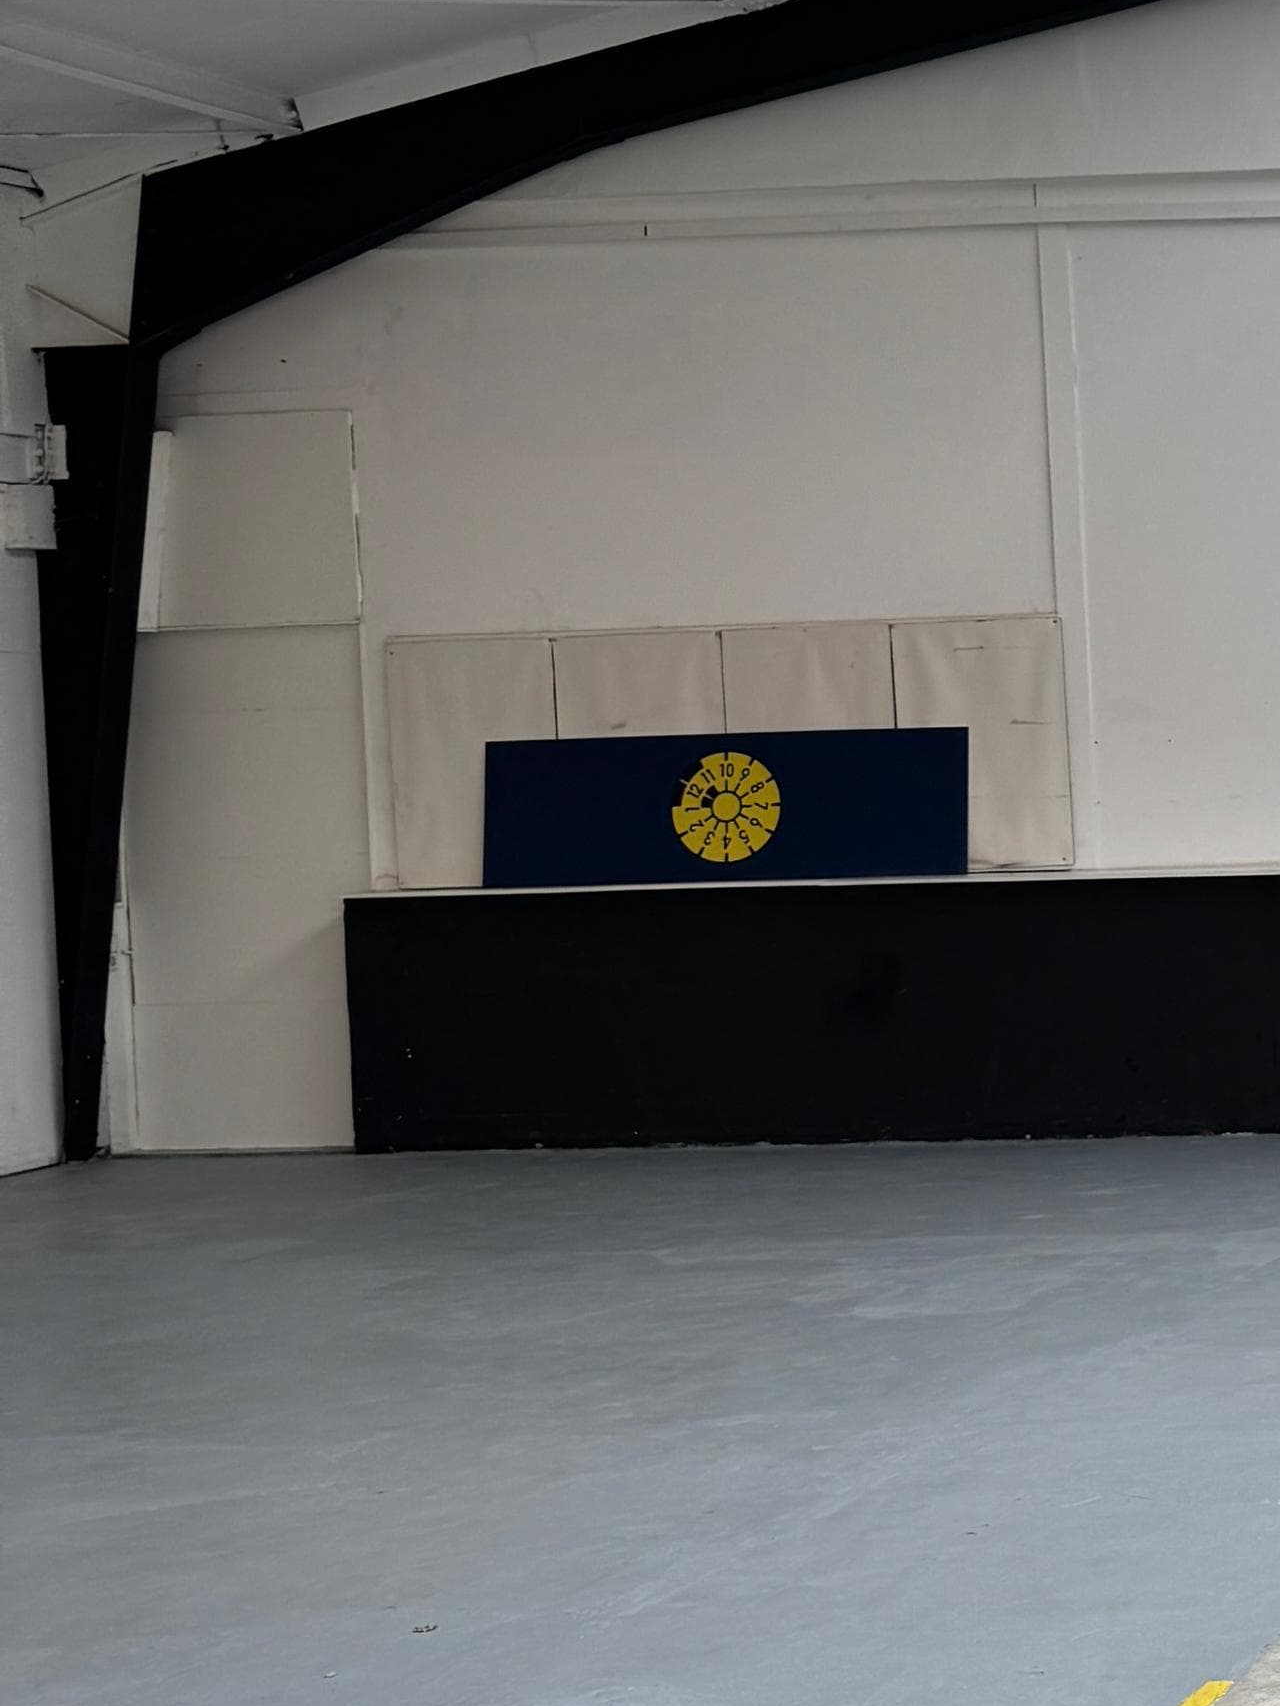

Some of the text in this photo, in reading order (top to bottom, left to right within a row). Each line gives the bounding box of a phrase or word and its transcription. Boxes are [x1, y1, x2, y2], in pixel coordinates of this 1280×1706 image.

[701, 763, 750, 783] 11 10 9
[687, 781, 765, 799] 12 8
[753, 801, 769, 811] 7
[689, 817, 764, 833] 2 6
[703, 829, 750, 851] 3 4 5
